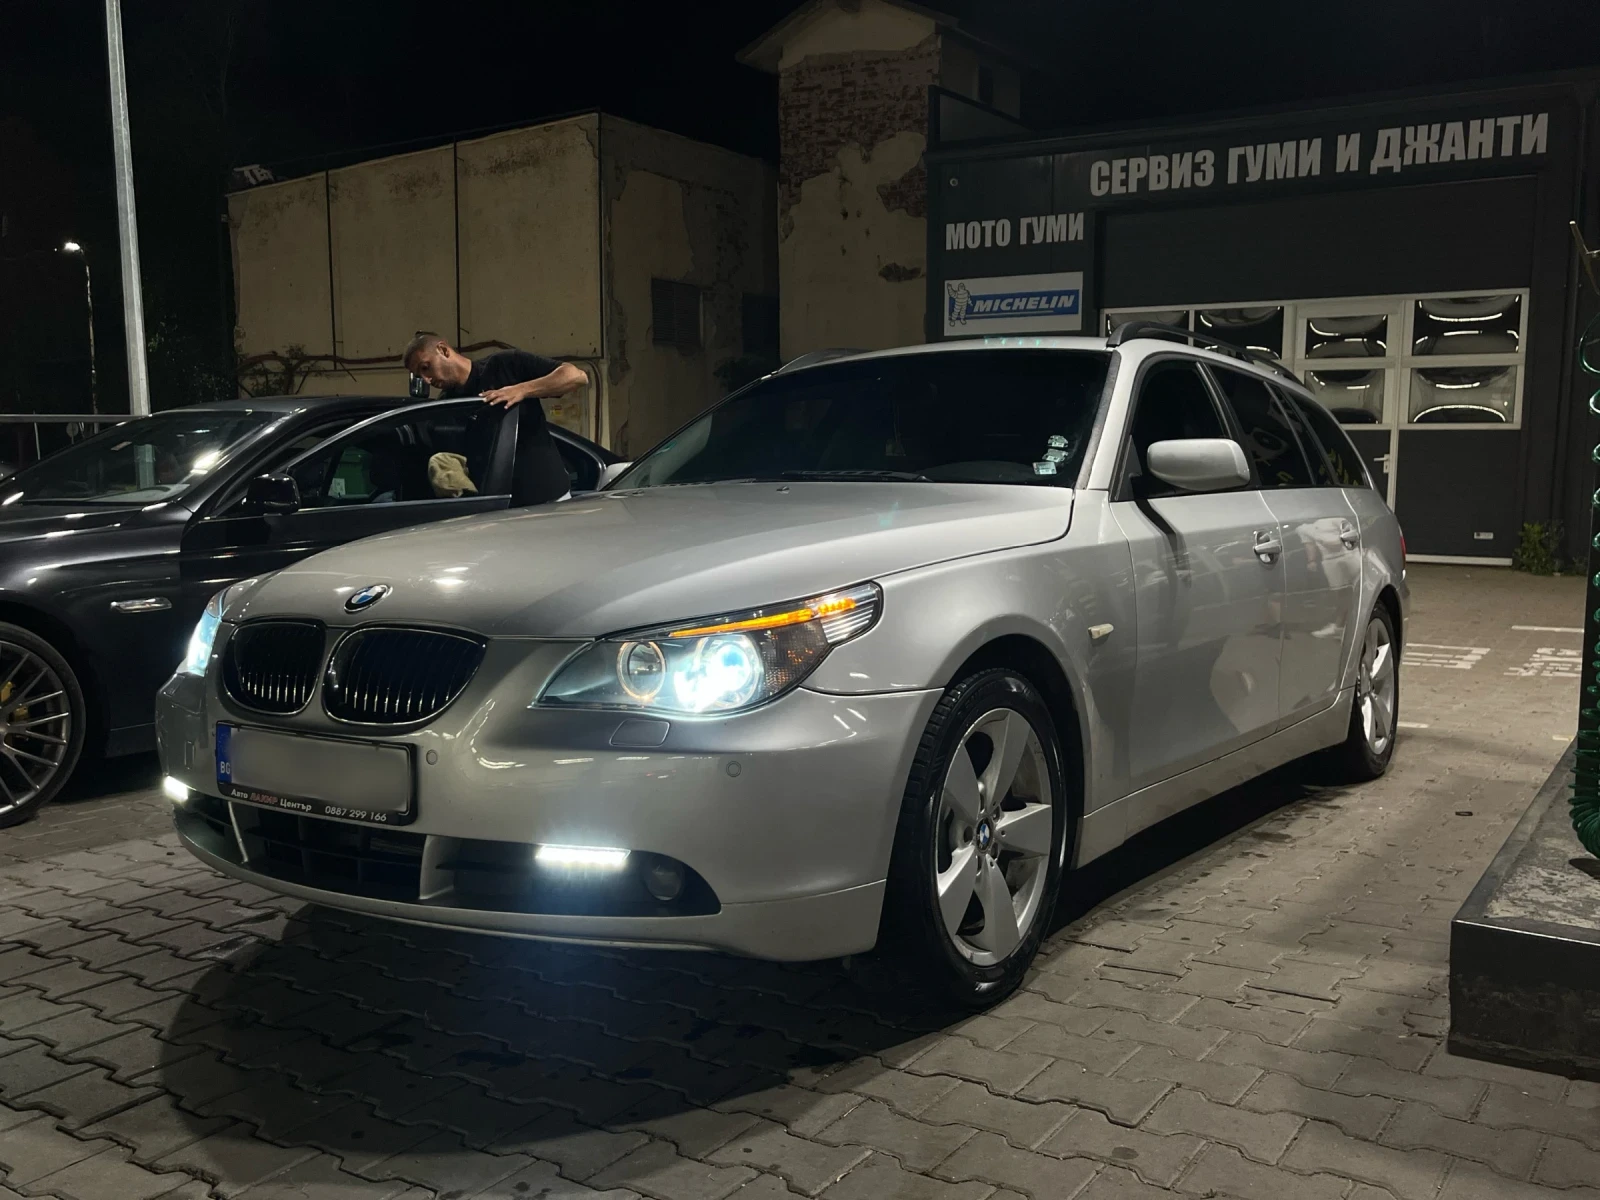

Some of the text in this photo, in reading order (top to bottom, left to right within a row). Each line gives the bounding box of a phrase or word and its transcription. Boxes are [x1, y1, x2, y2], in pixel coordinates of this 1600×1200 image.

[1090, 112, 1549, 197] СЕРВИЗ ГУМИ И ДЖАНТИ
[945, 212, 1084, 251] МОТО ГУМИ
[973, 294, 1075, 313] MICHELIN
[220, 761, 231, 775] BG
[231, 788, 249, 799] Авто
[280, 798, 312, 812] Център
[324, 805, 347, 816] 0887
[349, 809, 367, 820] 299
[370, 812, 387, 822] 166
